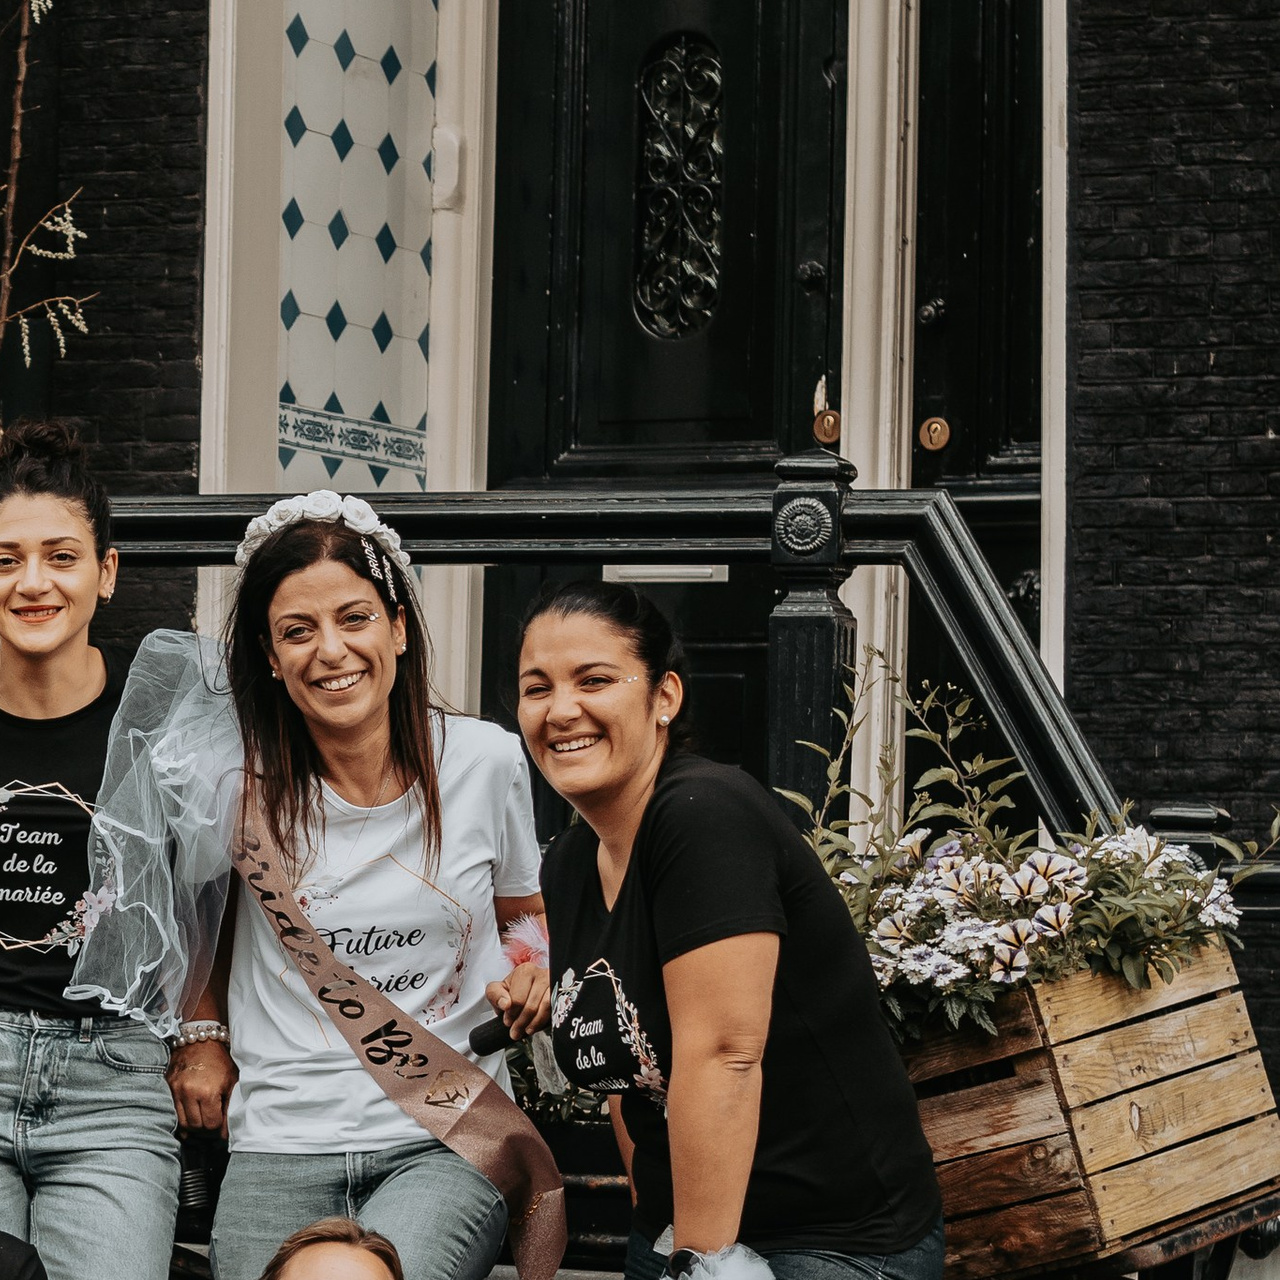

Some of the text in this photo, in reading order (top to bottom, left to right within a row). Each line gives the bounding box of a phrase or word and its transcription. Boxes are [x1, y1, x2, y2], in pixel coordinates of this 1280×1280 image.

[0, 822, 63, 845] Team
[2, 852, 58, 874] de la
[316, 925, 426, 956] Future
[358, 968, 429, 995] riée
[569, 1016, 604, 1040] Team
[575, 1045, 606, 1070] de la
